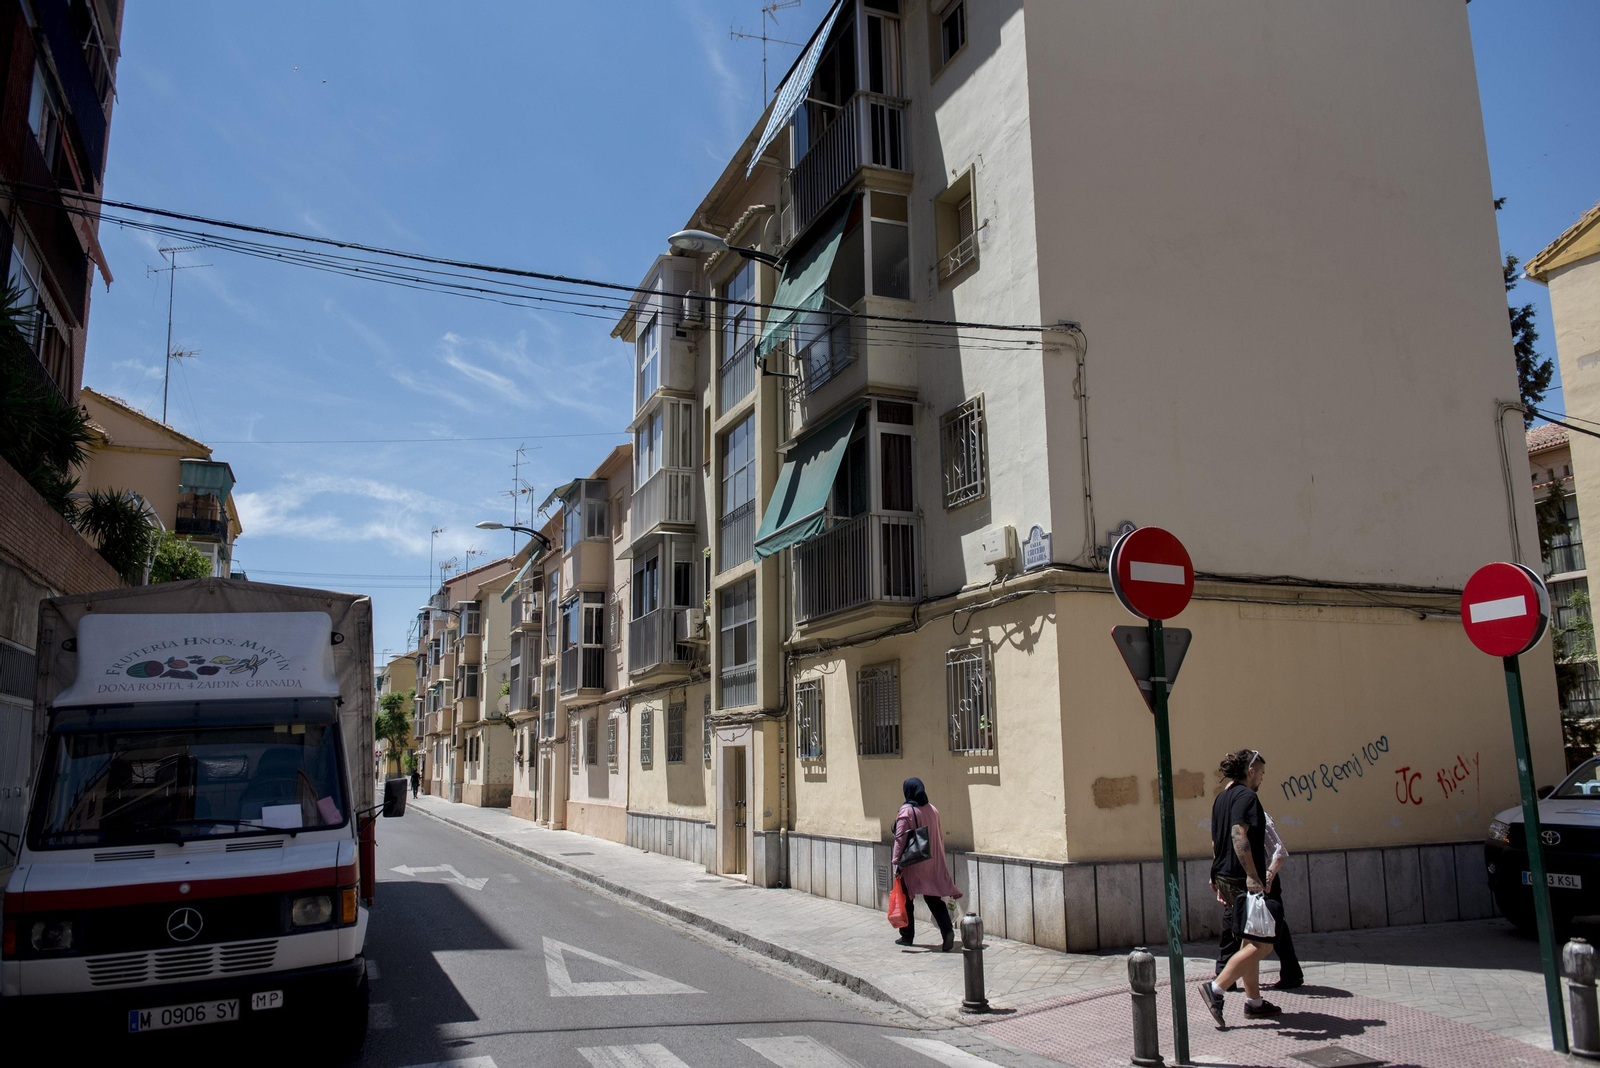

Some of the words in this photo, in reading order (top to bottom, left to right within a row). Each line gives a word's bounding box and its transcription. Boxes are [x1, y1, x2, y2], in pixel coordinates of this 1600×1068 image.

[106, 640, 178, 676] FRUTERÍA
[183, 637, 236, 646] HNOS.
[240, 640, 290, 671] MARTÍN
[98, 682, 134, 693] DOÑA
[1558, 875, 1578, 887] KSL
[140, 1011, 151, 1029] M
[161, 1005, 206, 1026] 0906
[216, 1001, 238, 1019] SY
